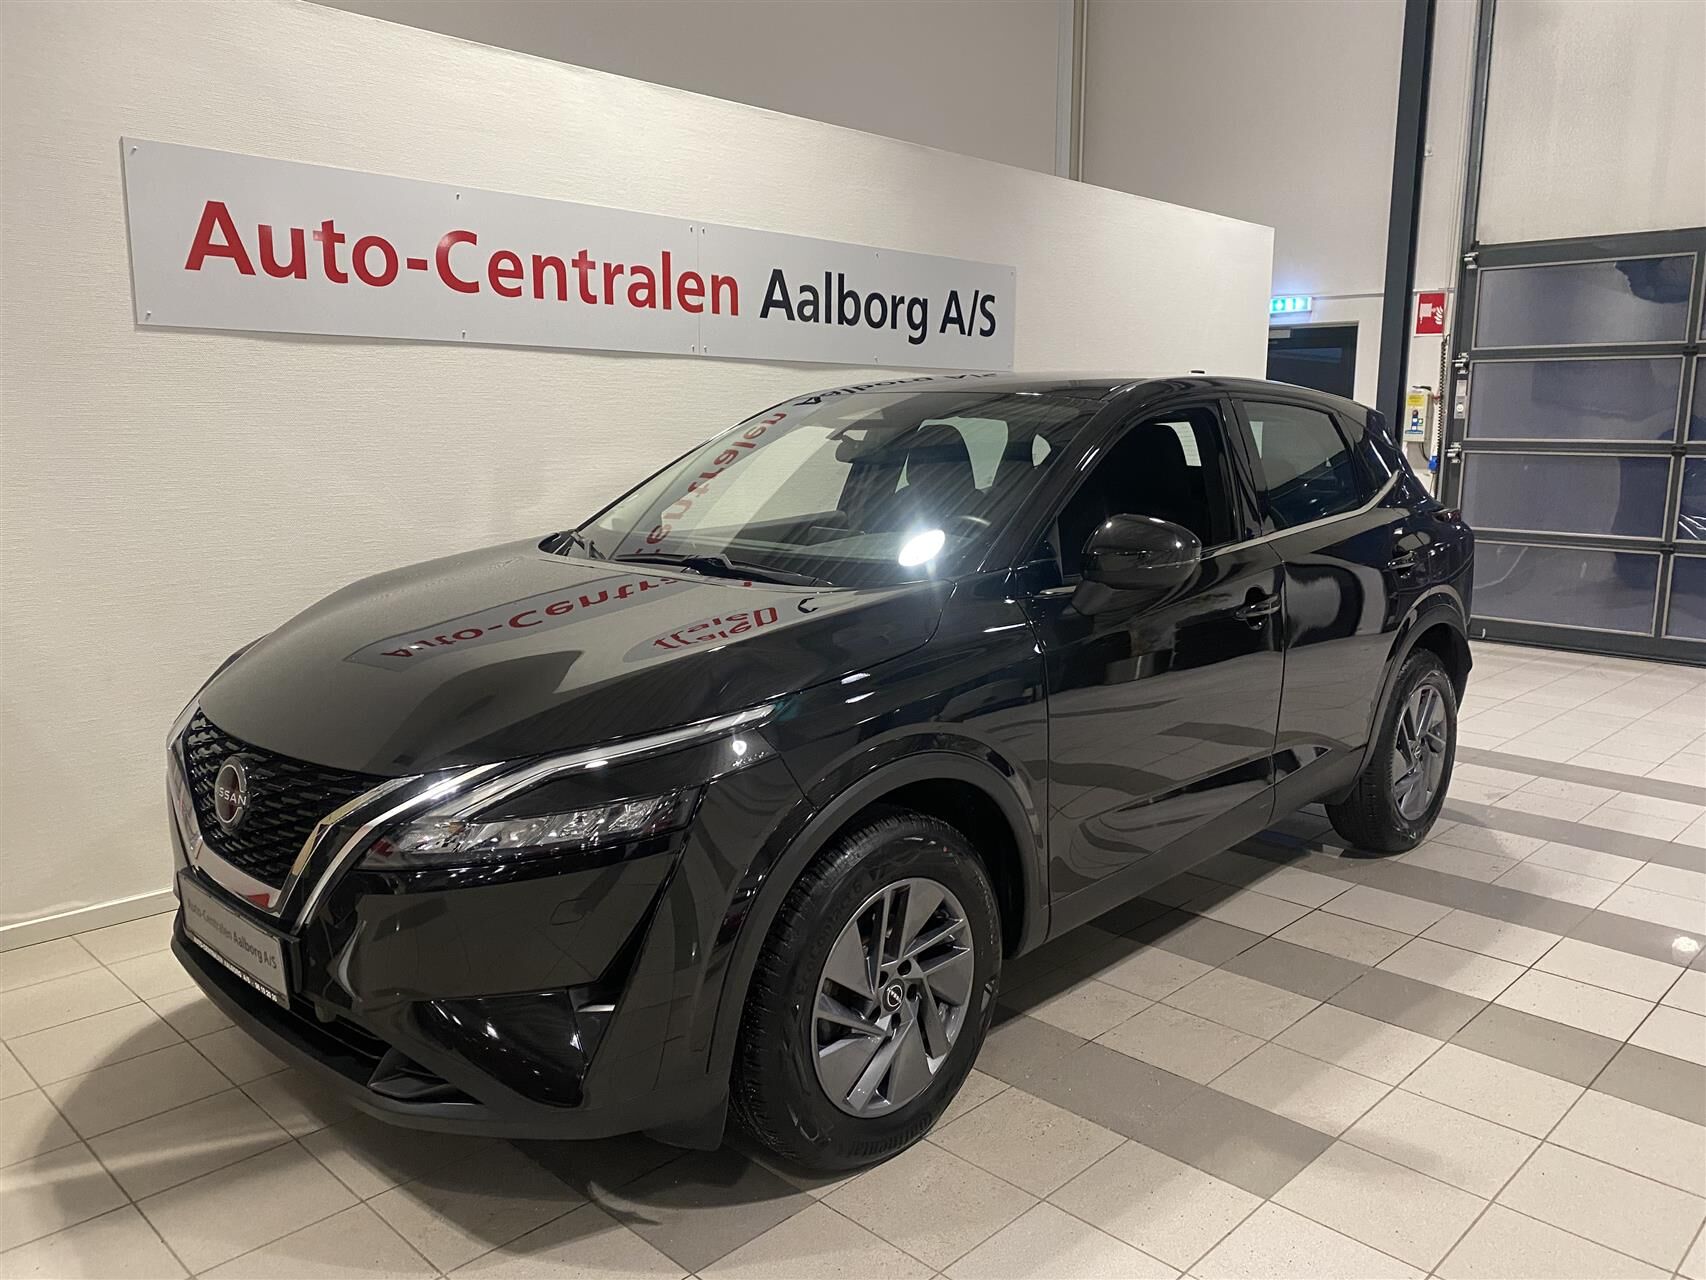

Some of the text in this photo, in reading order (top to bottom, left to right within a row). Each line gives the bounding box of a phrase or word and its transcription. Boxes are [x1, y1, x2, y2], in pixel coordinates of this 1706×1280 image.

[185, 200, 996, 345] Auto-Centralen Aalborg A/S
